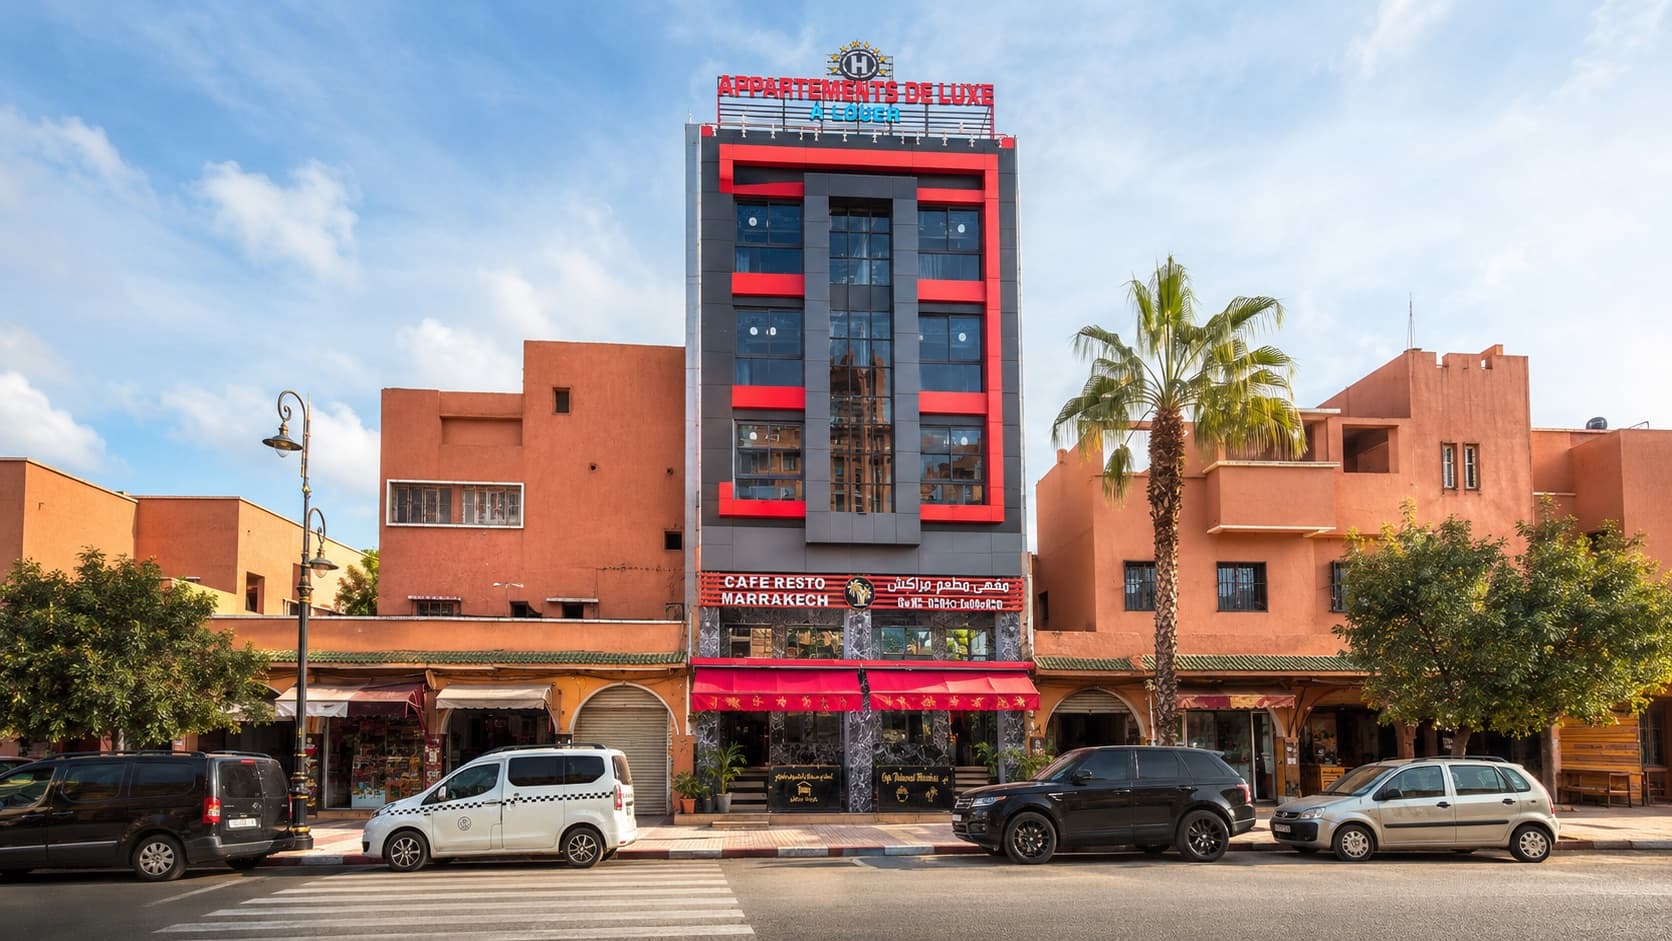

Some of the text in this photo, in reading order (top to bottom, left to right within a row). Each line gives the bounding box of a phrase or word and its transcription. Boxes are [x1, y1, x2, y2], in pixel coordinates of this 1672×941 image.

[851, 55, 868, 75] H
[718, 75, 995, 106] APPARTEMENTS DE LUXE
[831, 103, 901, 123] LOUER
[724, 576, 826, 590] CAFE RESTO
[887, 576, 932, 593] مراكش
[936, 577, 970, 595] مطعم
[721, 592, 829, 607] MARRAKECH
